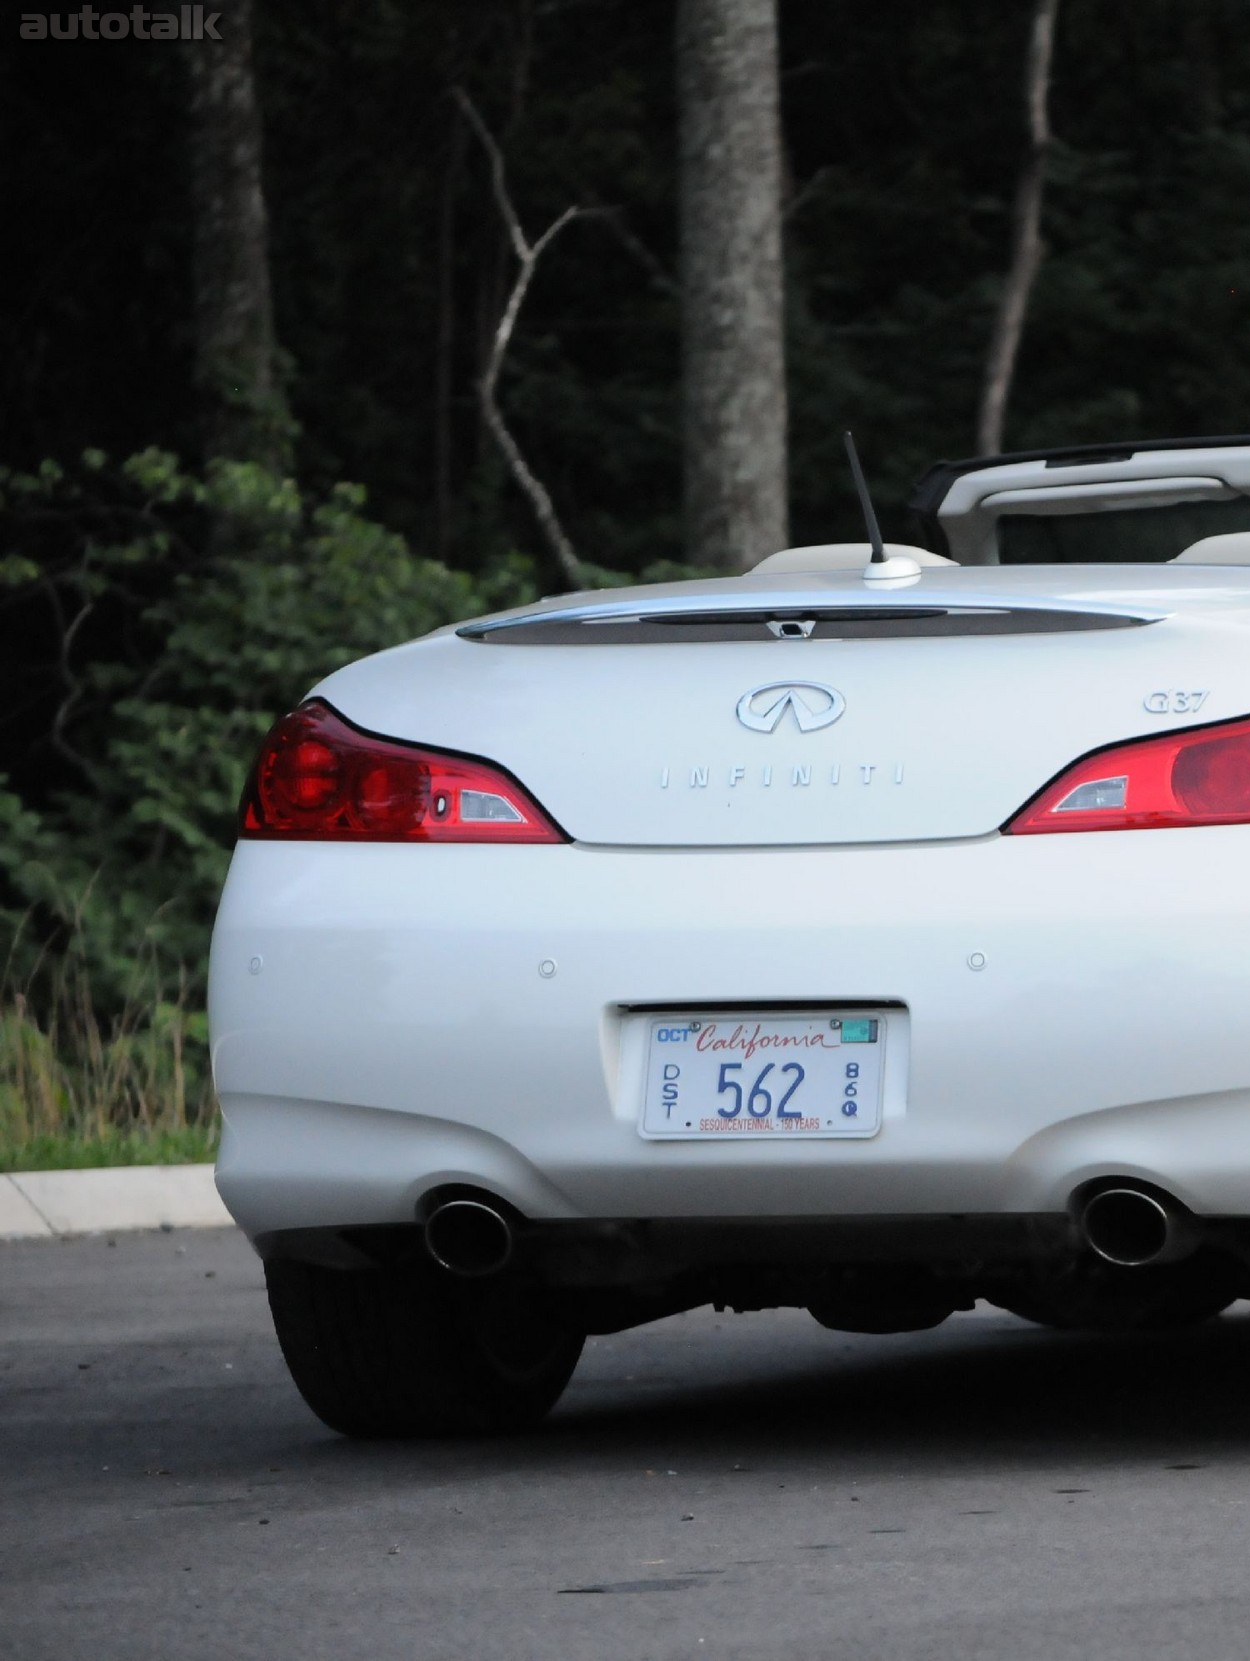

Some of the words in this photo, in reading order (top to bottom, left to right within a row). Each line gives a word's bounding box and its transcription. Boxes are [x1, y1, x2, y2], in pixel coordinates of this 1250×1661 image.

[1142, 688, 1211, 715] G37
[661, 764, 906, 788] INFINITI
[657, 1028, 690, 1043] OCT
[697, 1024, 841, 1060] California
[717, 1062, 806, 1119] 562
[699, 1118, 774, 1131] SESQUICENTENNIAL
[780, 1118, 794, 1130] 150
[794, 1117, 820, 1130] YEARS
